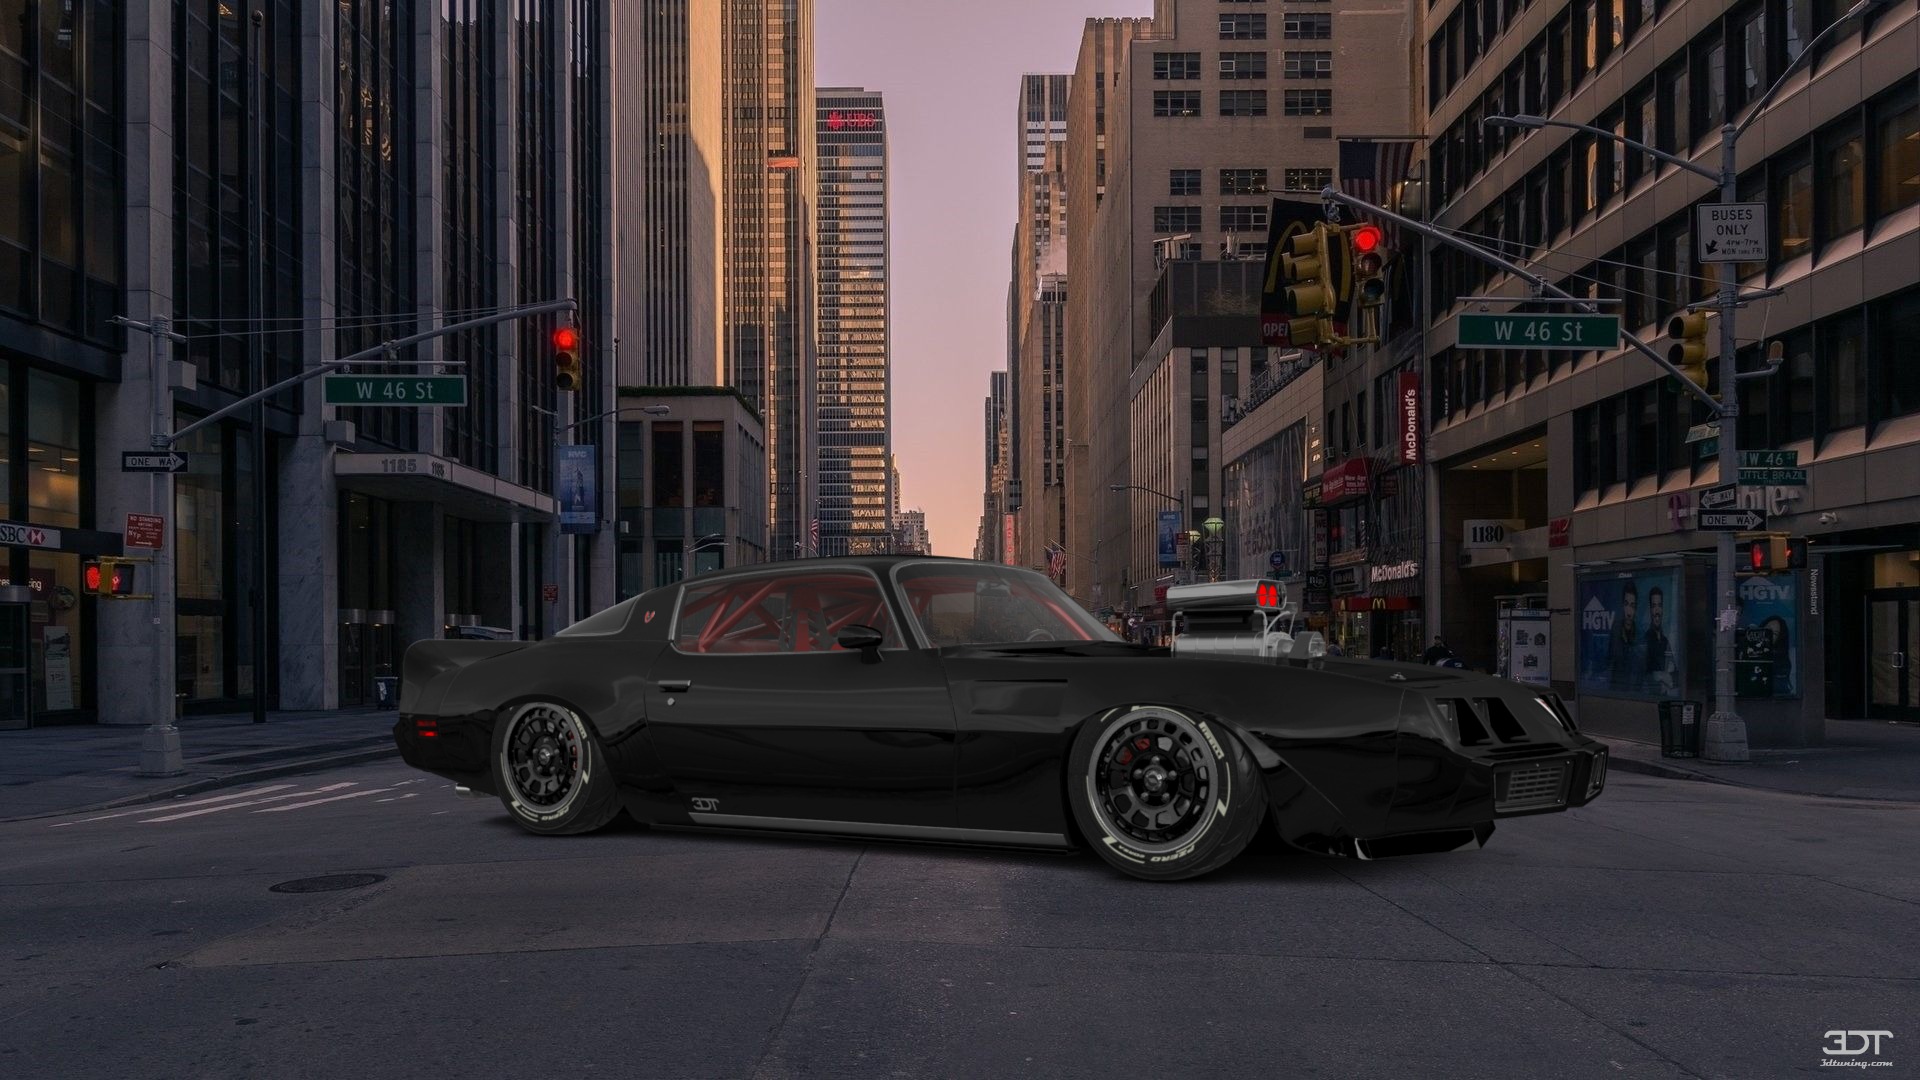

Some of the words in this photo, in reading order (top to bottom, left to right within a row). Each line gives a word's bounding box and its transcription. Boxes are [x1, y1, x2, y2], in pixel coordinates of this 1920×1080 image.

[1711, 209, 1753, 221] BUSES
[1716, 224, 1748, 236] ONLY
[1494, 321, 1514, 341] W
[1524, 321, 1551, 342] 46
[1561, 322, 1583, 342] St
[356, 381, 373, 399] W
[383, 381, 406, 400] 46
[415, 381, 434, 400] St
[1404, 388, 1417, 461] McDonald's
[131, 457, 151, 466] ONE
[159, 457, 178, 466] WAY
[381, 458, 417, 473] 1185
[1749, 452, 1760, 468] W
[1765, 452, 1784, 466] 46
[1738, 471, 1768, 481] LITTLE
[1771, 471, 1807, 481] BRAZIL
[1703, 494, 1715, 504] ONE
[1719, 490, 1732, 501] WAY
[1707, 515, 1727, 525] ONE
[1736, 515, 1757, 525] WAY
[1472, 525, 1504, 543] 1180
[1371, 560, 1419, 583] McDonald's
[1740, 585, 1791, 600] HGTV
[1582, 610, 1616, 631] HGTV
[691, 797, 720, 811] 3DT
